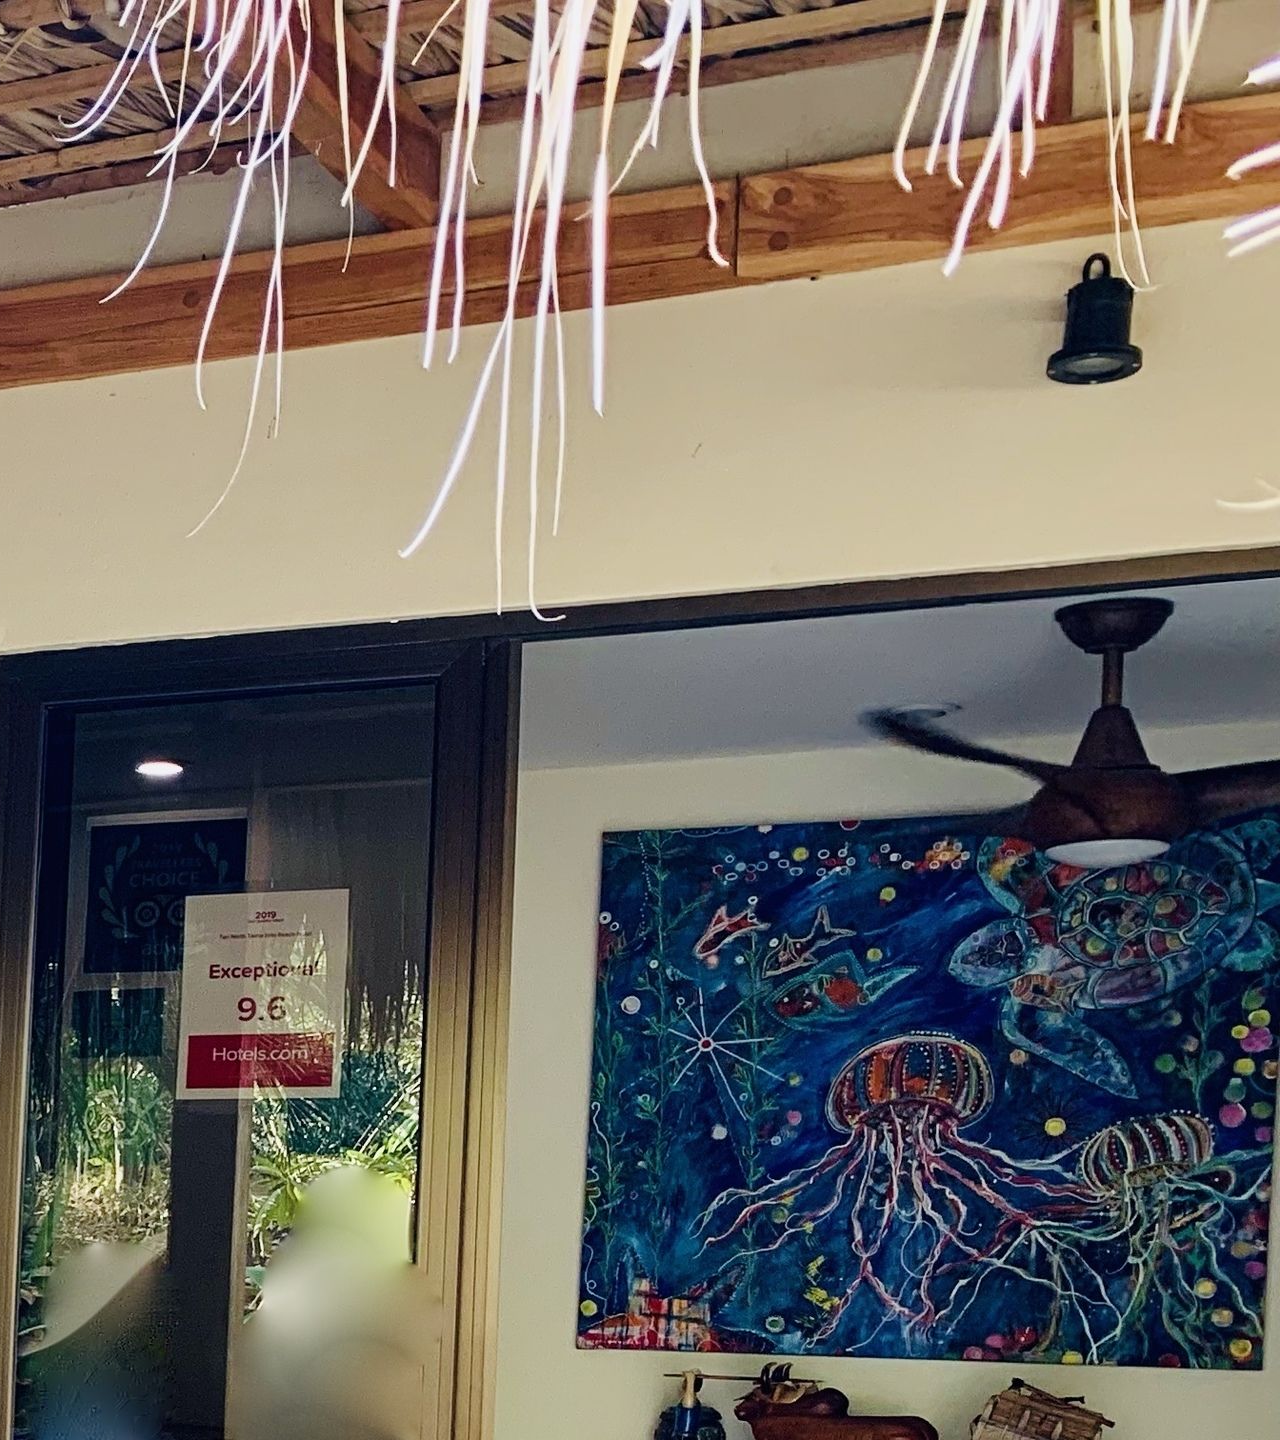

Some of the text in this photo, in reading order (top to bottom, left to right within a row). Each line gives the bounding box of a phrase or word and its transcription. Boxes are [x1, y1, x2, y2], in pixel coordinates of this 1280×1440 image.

[129, 871, 200, 887] CHOICE
[255, 910, 277, 920] 2019
[237, 995, 287, 1022] 9.6
[212, 1046, 308, 1062] Hotels.com
